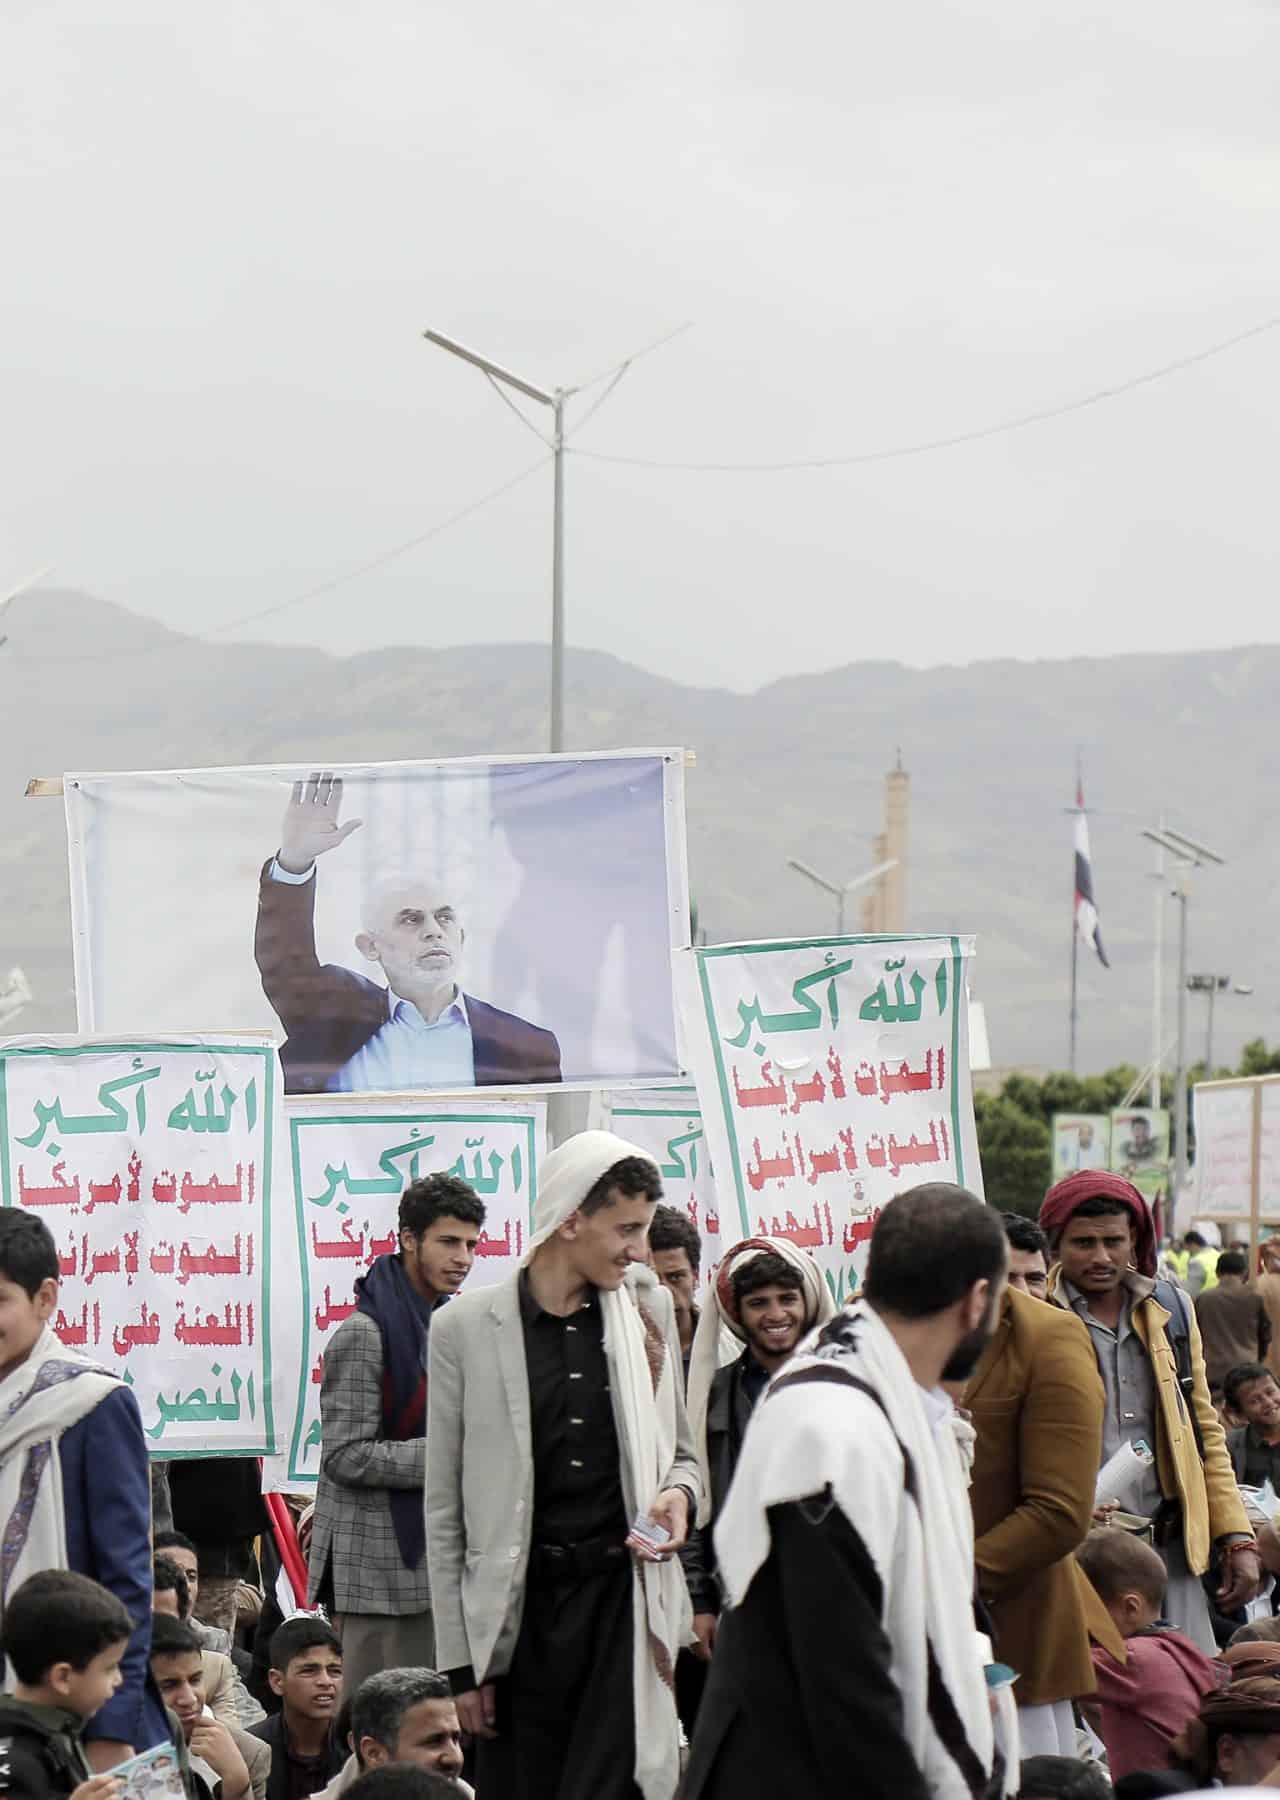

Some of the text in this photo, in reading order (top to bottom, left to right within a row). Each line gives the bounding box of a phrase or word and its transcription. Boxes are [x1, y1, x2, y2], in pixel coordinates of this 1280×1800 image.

[723, 951, 948, 1057] الله أكبر
[854, 1043, 945, 1105] الموت
[14, 1057, 257, 1157] الله أكبر
[866, 1116, 949, 1178] الموت
[18, 1149, 143, 1216] لأمريكا
[152, 1160, 255, 1214] الموت
[150, 1231, 255, 1286] الموت
[311, 1216, 523, 1267] الم مريكا
[112, 1300, 161, 1356] على
[174, 1300, 254, 1347] اللعنة
[144, 1362, 255, 1440] النصر
